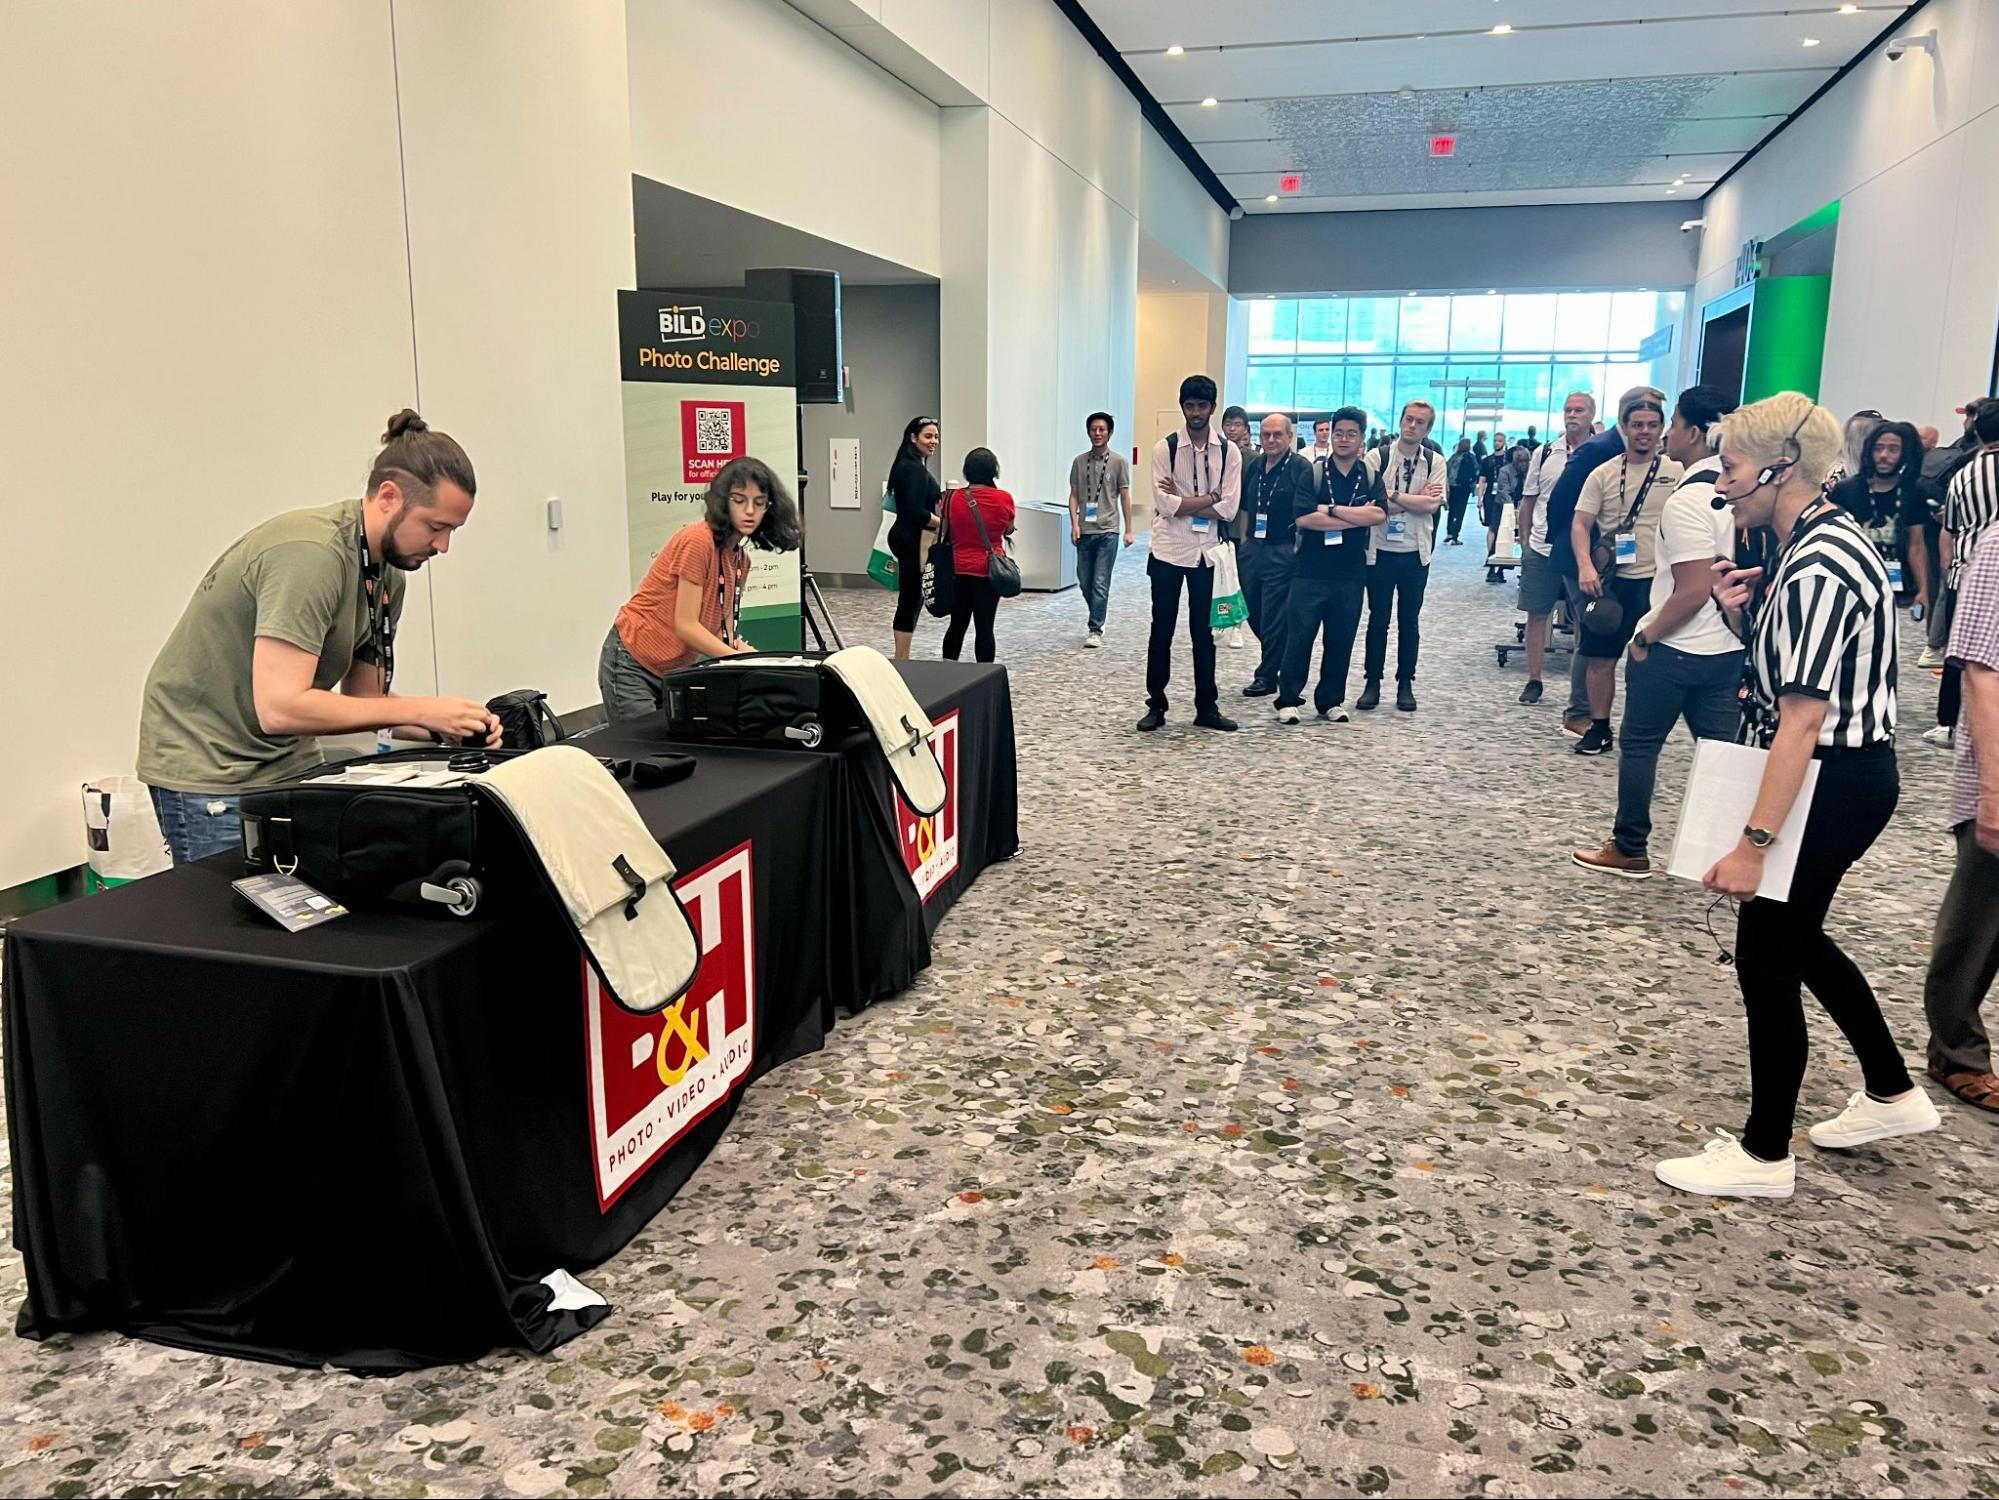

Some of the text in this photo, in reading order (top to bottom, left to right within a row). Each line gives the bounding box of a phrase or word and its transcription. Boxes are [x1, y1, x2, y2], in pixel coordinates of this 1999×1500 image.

[708, 317, 760, 343] expo
[639, 347, 781, 377] Photo Challenge
[688, 459, 732, 469] SCAN HE
[688, 470, 700, 478] for
[651, 491, 673, 504] Play
[674, 491, 688, 501] for
[608, 1039, 749, 1173] PHOTO VIDEO AUDIO
